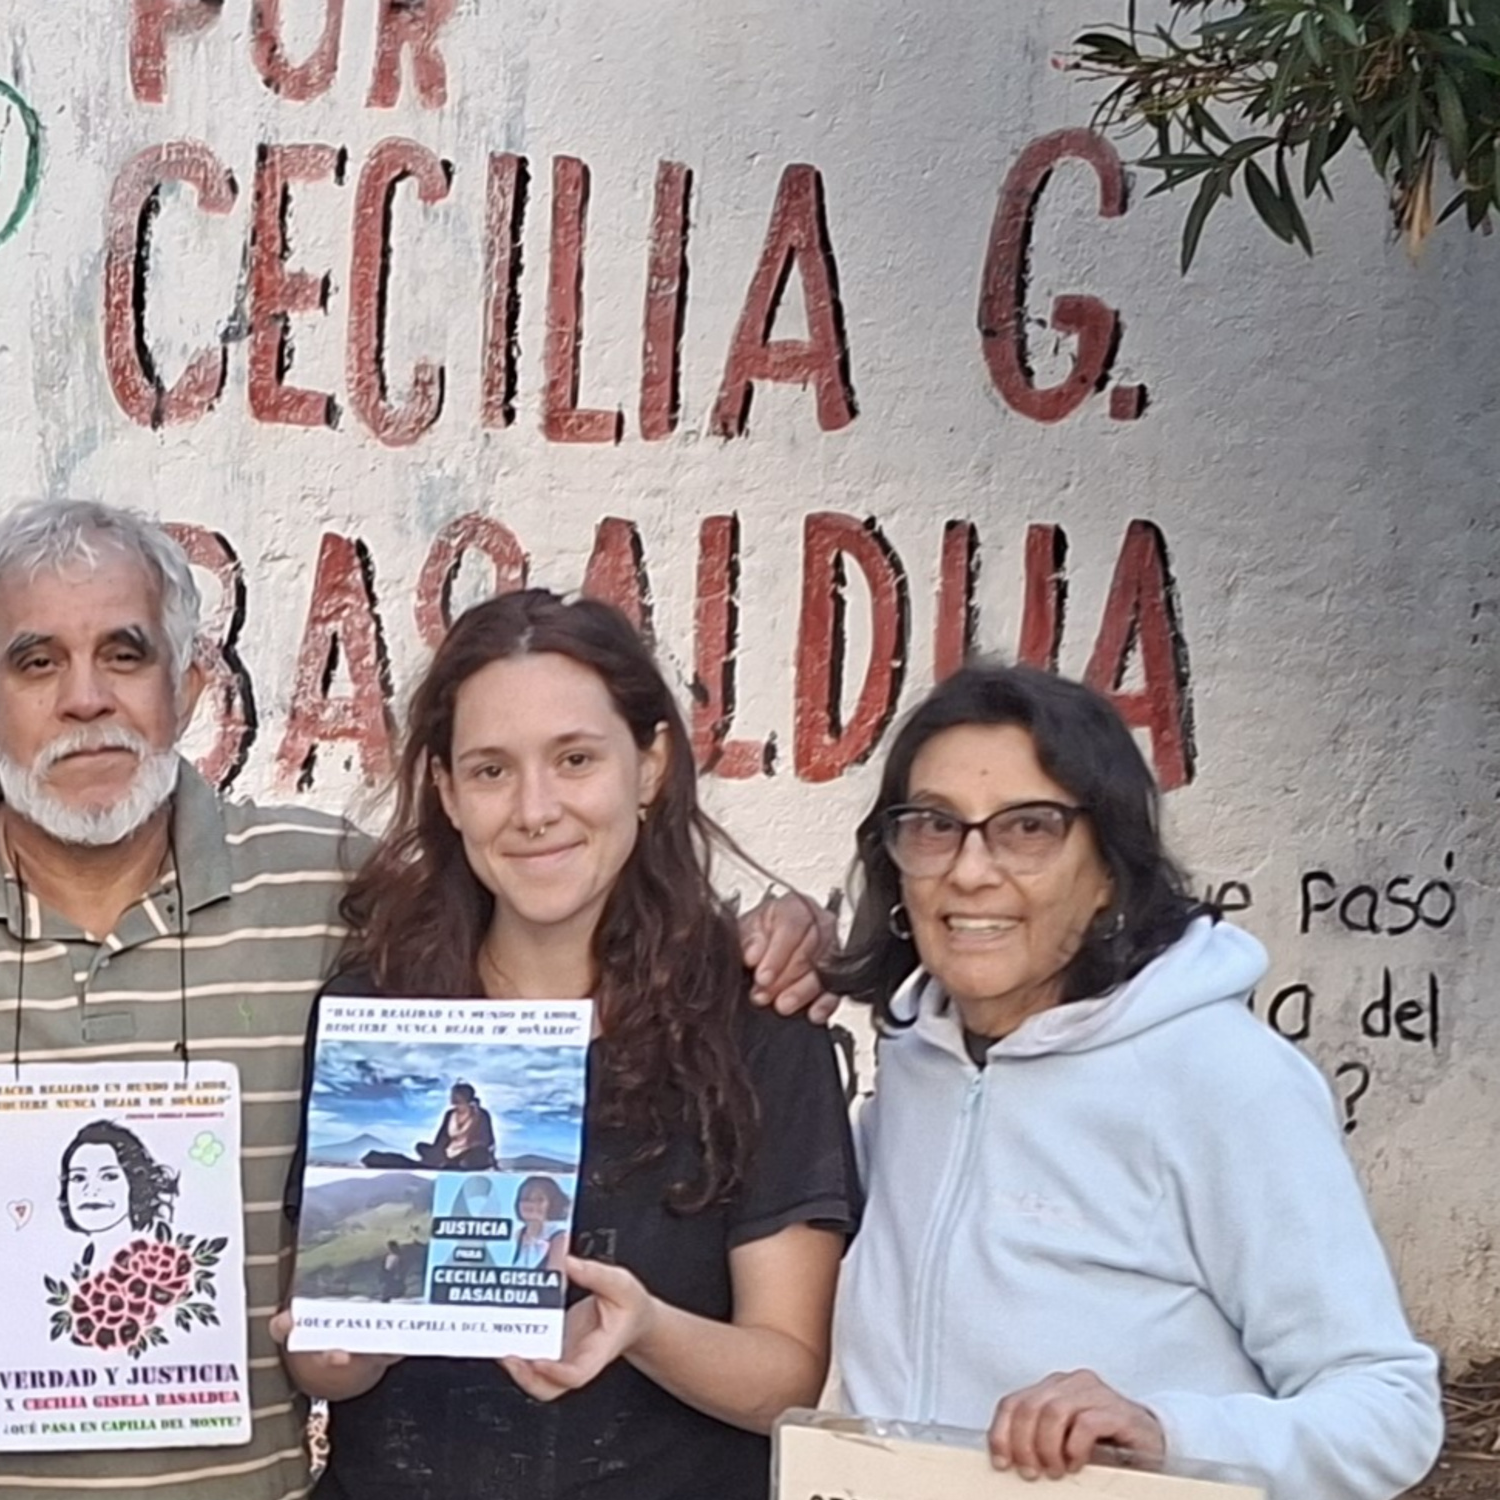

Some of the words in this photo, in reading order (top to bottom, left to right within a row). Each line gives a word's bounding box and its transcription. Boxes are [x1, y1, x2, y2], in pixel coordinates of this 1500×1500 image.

[101, 136, 858, 446] CECILIA
[978, 128, 1149, 422] G.
[1361, 967, 1439, 1048] del
[56, 1099, 96, 1109] NUNCA
[435, 1221, 508, 1236] JUSTICIA
[434, 1270, 497, 1284] CECILIA
[500, 1271, 559, 1287] GISELA
[448, 1287, 539, 1304] BASALDUA
[376, 1319, 394, 1330] EN
[398, 1319, 456, 1331] CAPILLA
[0, 1368, 97, 1390] VERDAD
[104, 1368, 119, 1387] Y
[126, 1363, 240, 1385] JUSTICIA
[4, 1399, 15, 1411] X
[23, 1397, 88, 1411] CECILIA
[93, 1394, 150, 1409] GISELA
[155, 1391, 241, 1406] BASALDUA
[3, 1421, 37, 1435] ¿QUÉ
[42, 1421, 76, 1434] PASA
[80, 1421, 97, 1432] EN
[101, 1420, 156, 1432] CAPILLA
[160, 1418, 184, 1430] DEL
[189, 1416, 242, 1429] MONTE?
